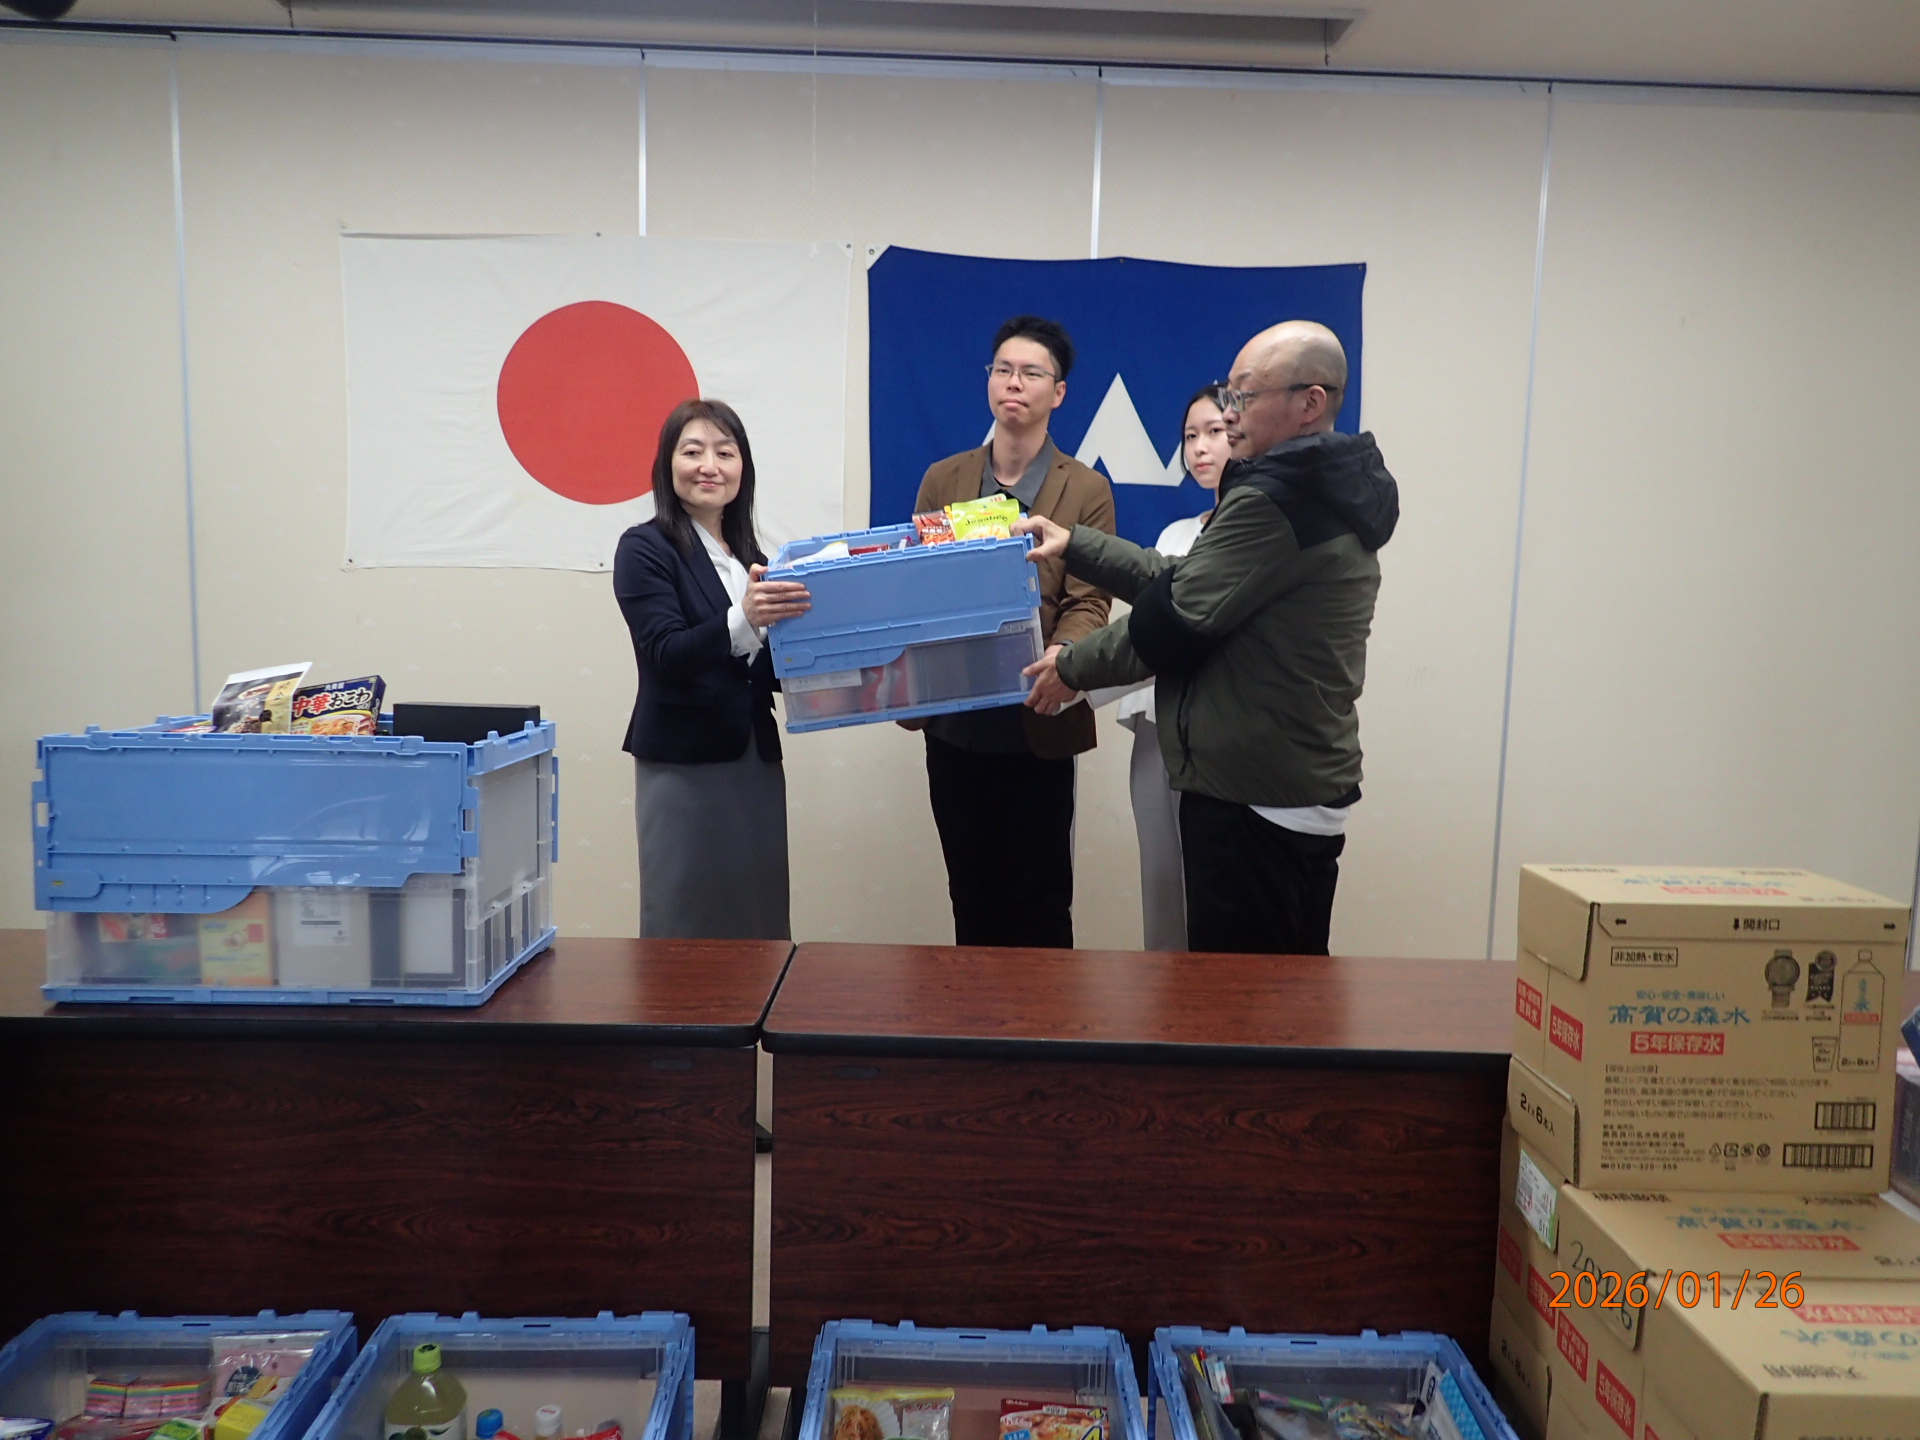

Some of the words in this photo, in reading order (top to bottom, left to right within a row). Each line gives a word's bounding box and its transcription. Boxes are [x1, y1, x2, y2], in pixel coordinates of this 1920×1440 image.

[293, 688, 373, 718] 中華おこわ
[1743, 919, 1780, 931] 開封口
[1614, 951, 1674, 963] 非加熱・軟水
[1608, 1004, 1750, 1025] 高賀の森水
[1552, 1013, 1581, 1052] 5年保存水
[1634, 1034, 1721, 1053] 5年保存水
